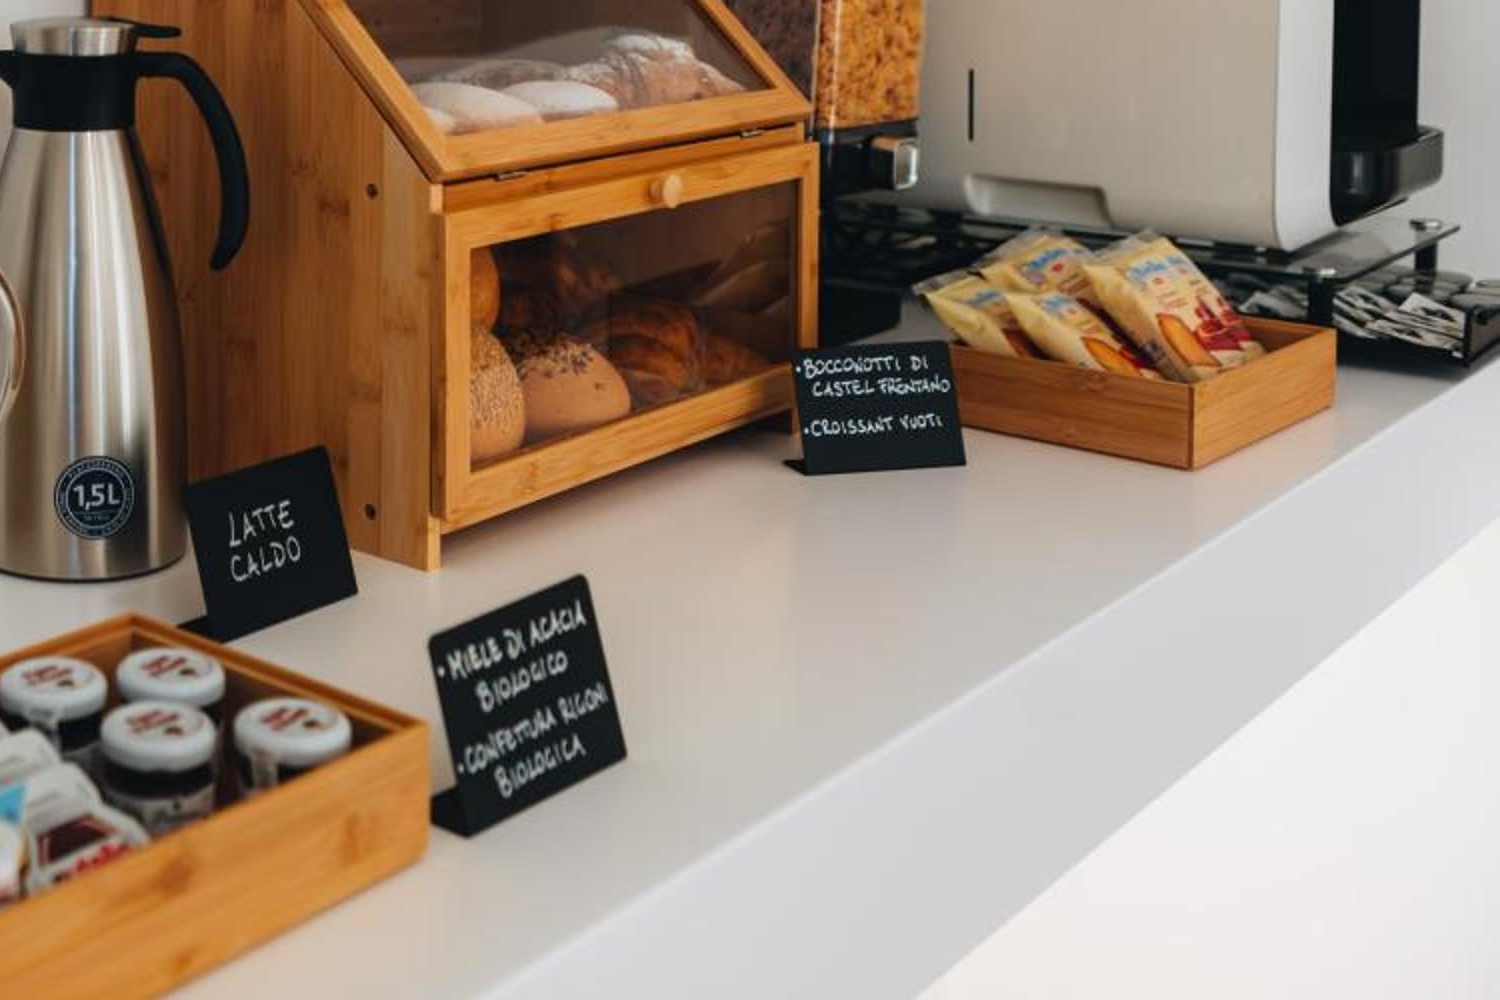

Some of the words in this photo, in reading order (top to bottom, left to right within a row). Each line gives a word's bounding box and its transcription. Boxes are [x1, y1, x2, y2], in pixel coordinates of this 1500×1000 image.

[803, 356, 901, 379] BOCCONOTTI
[911, 355, 929, 372] DI
[812, 379, 875, 397] CASTEL
[877, 374, 951, 396] FRENTANO
[811, 416, 893, 437] CROISSANT
[900, 412, 943, 430] VUOTI
[72, 482, 121, 511] 1,5L
[228, 500, 294, 548] LATTE
[230, 536, 300, 582] CALDO
[446, 637, 503, 680] MIELE
[503, 628, 526, 660] DI
[530, 600, 587, 648] ACACIA
[475, 650, 568, 713] BIOLOGICO
[464, 706, 557, 774] CONFETTURA
[494, 734, 587, 798] BIOLOGICA
